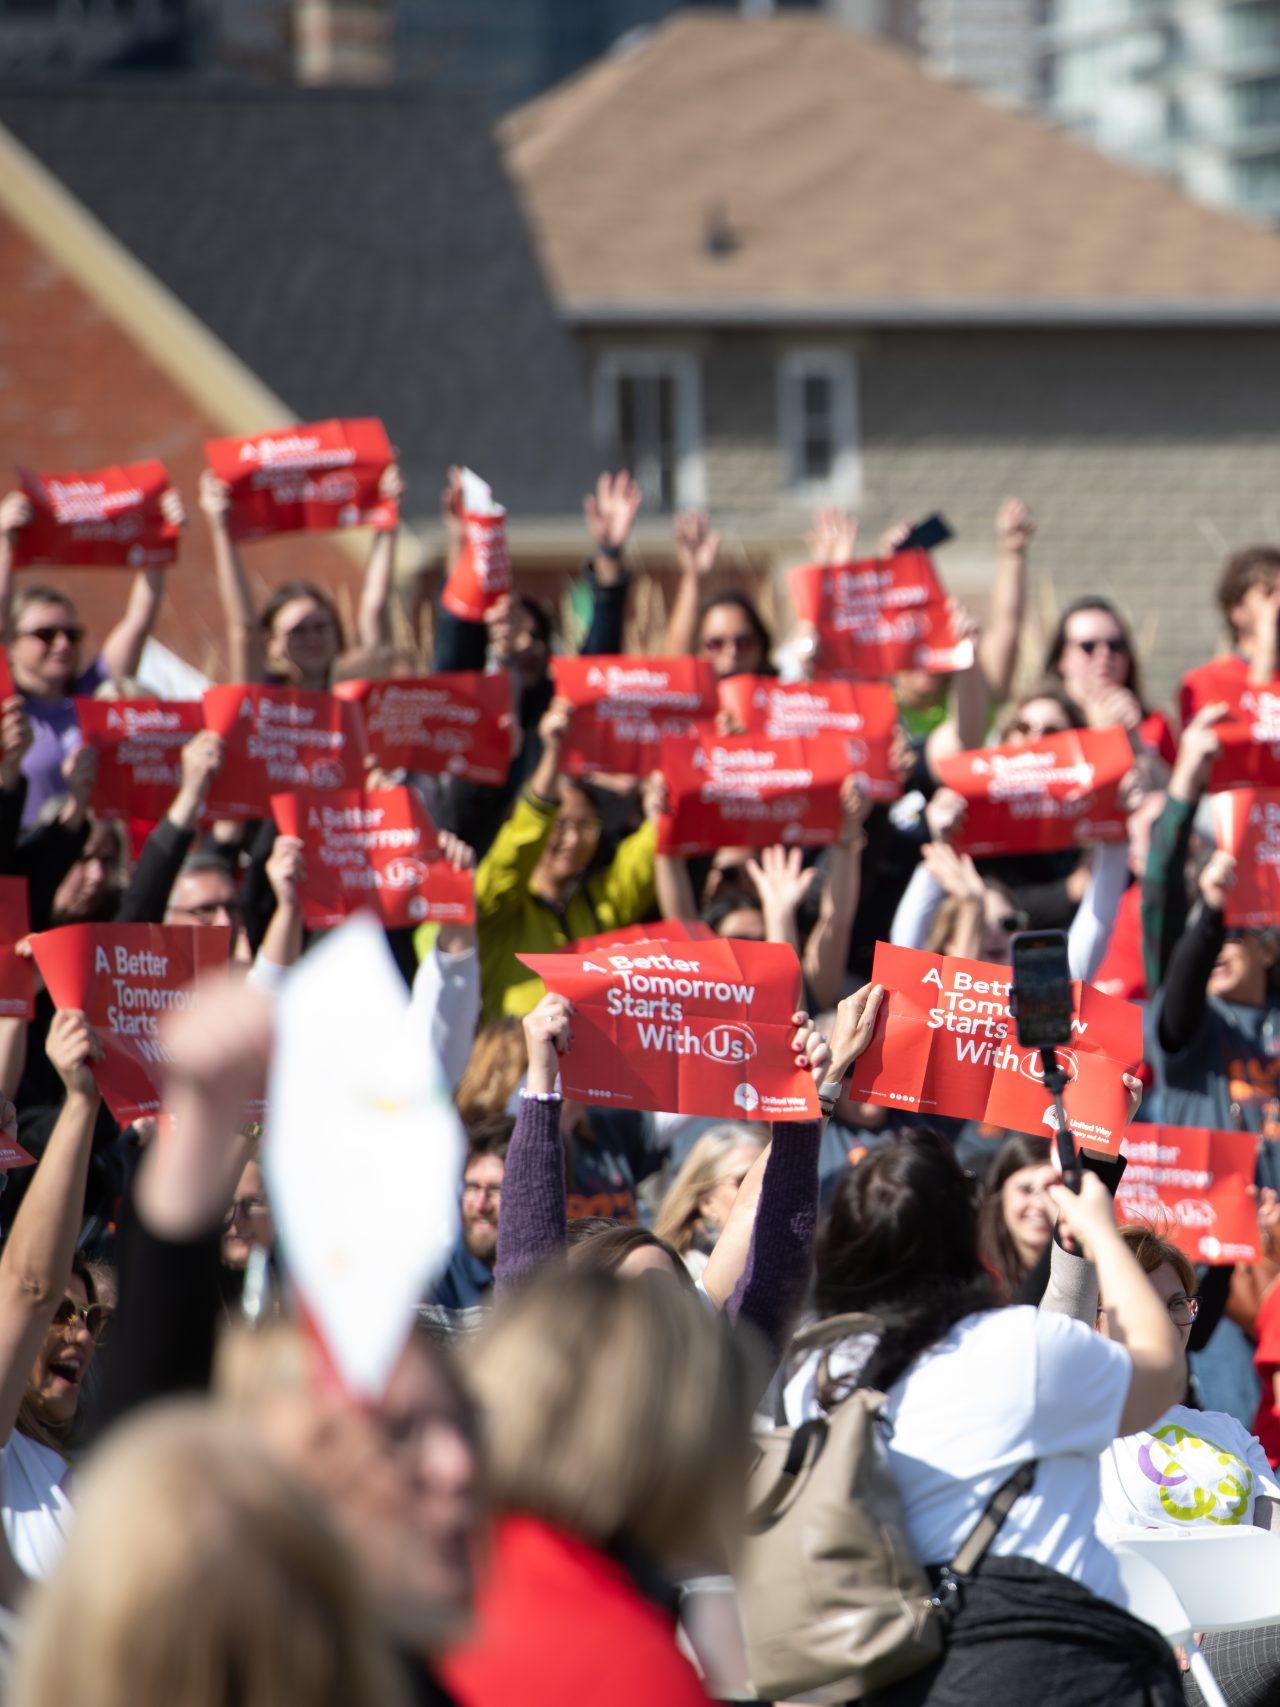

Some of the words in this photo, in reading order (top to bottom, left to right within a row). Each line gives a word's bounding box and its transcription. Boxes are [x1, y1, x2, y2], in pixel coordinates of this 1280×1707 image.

[258, 698, 316, 725] Better
[307, 805, 321, 828] A
[321, 805, 386, 830] Better
[320, 825, 421, 851] Tomorrow
[339, 863, 384, 889] With
[95, 944, 111, 975] A
[114, 945, 168, 978] Better
[582, 959, 608, 975] A
[608, 954, 701, 973] Better
[612, 969, 756, 1005] Tomorrow
[921, 967, 945, 990] A
[953, 971, 1013, 997] Bett
[606, 987, 684, 1023] Starts
[107, 1005, 160, 1037] Starts
[926, 1007, 1009, 1041] Starts
[636, 1022, 701, 1056] With
[708, 1029, 751, 1061] Us.
[955, 1037, 1020, 1073] With
[1121, 1164, 1214, 1190] omorrow
